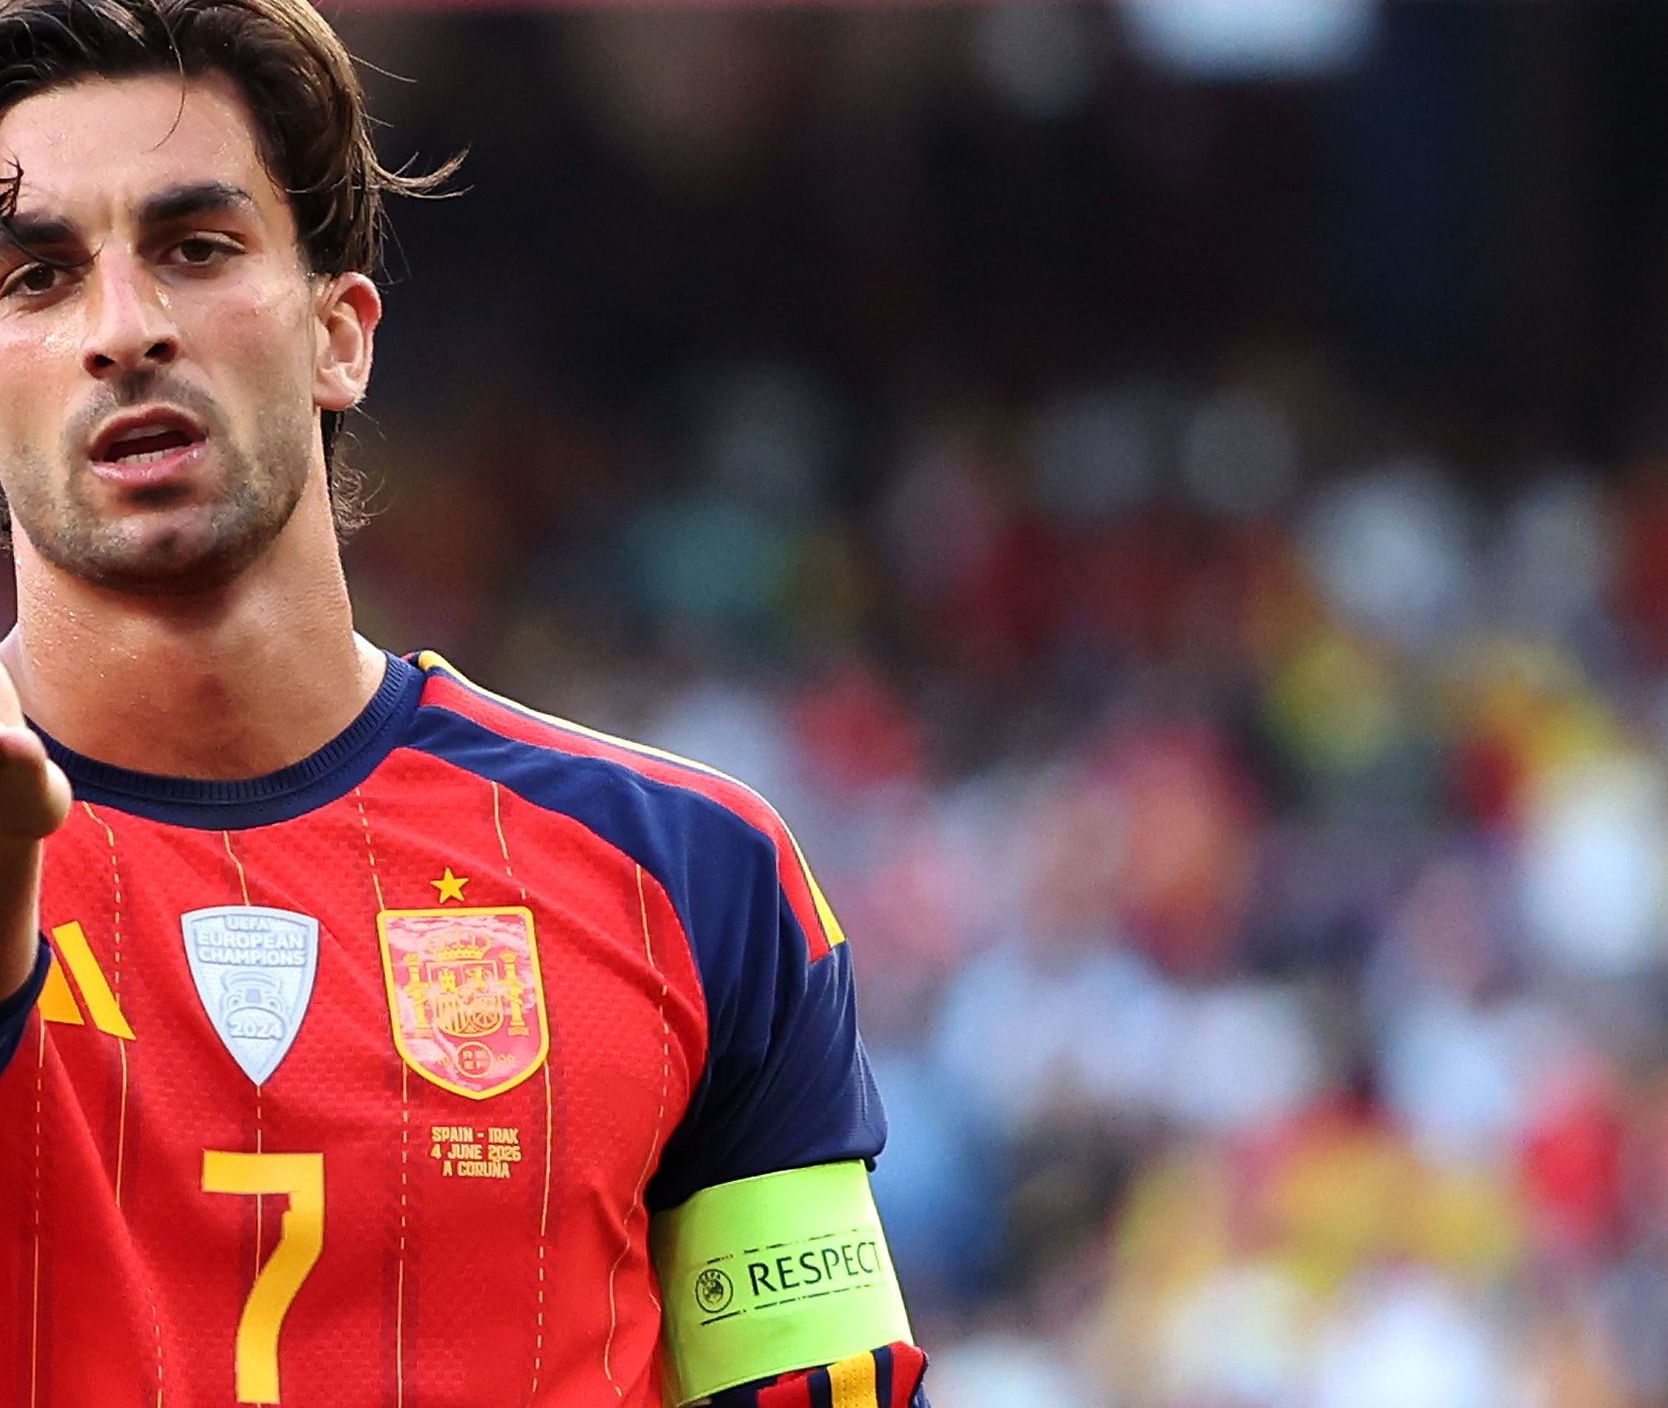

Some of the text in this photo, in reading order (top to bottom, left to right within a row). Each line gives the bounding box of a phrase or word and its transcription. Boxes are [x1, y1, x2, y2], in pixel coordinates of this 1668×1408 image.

[229, 916, 270, 931] UEFA
[198, 929, 306, 949] EUROPEAN
[198, 948, 307, 966] CHAMPIONS
[230, 1021, 282, 1039] 2024
[432, 1127, 473, 1142] SPAIN
[488, 1128, 518, 1144] IRAK
[431, 1144, 521, 1161] 4 JUNE 2026
[443, 1160, 510, 1178] A CORUÑA
[201, 1149, 324, 1404] 7
[747, 1241, 882, 1296] RESPECT
